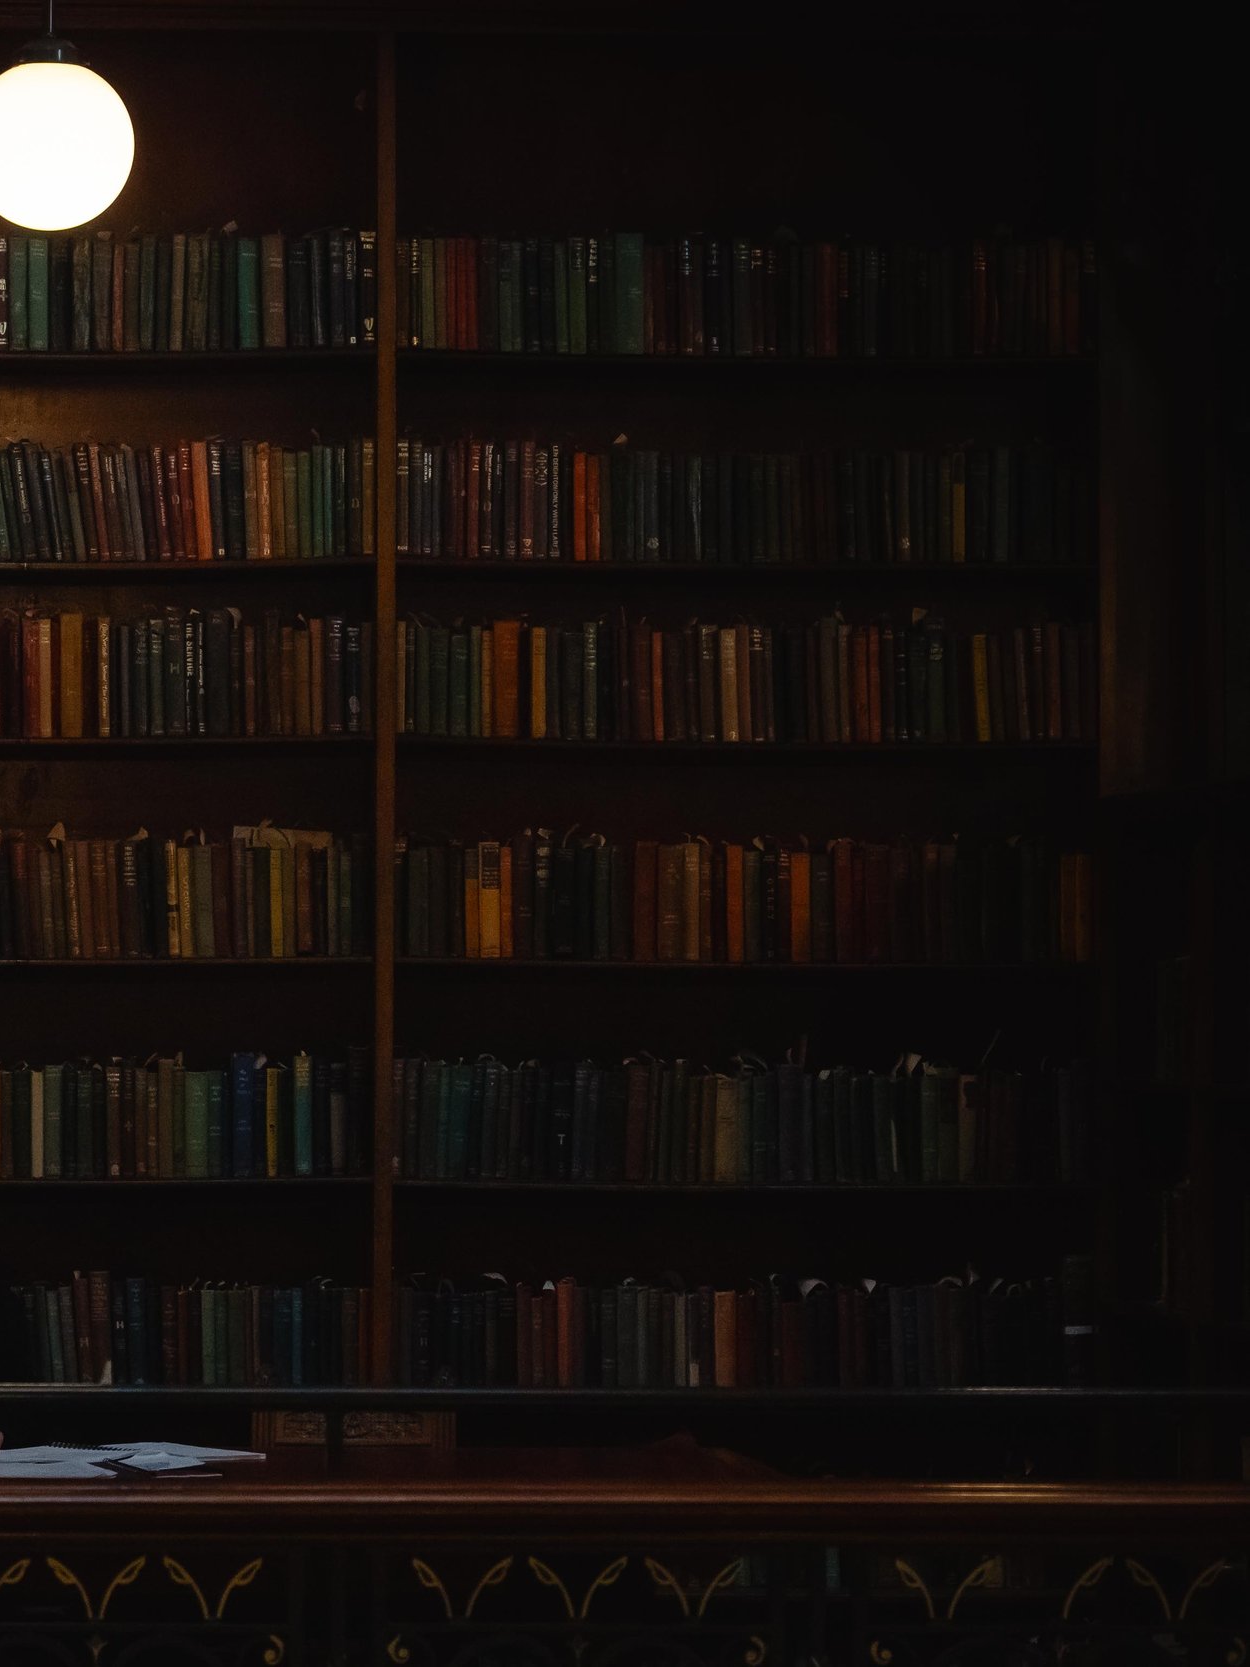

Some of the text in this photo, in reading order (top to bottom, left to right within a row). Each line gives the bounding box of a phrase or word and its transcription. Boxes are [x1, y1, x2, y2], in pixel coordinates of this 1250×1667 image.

[186, 623, 194, 638] THE
[186, 641, 194, 677] SERVICE
[767, 879, 775, 920] OTLEY
[557, 1134, 566, 1145] T
